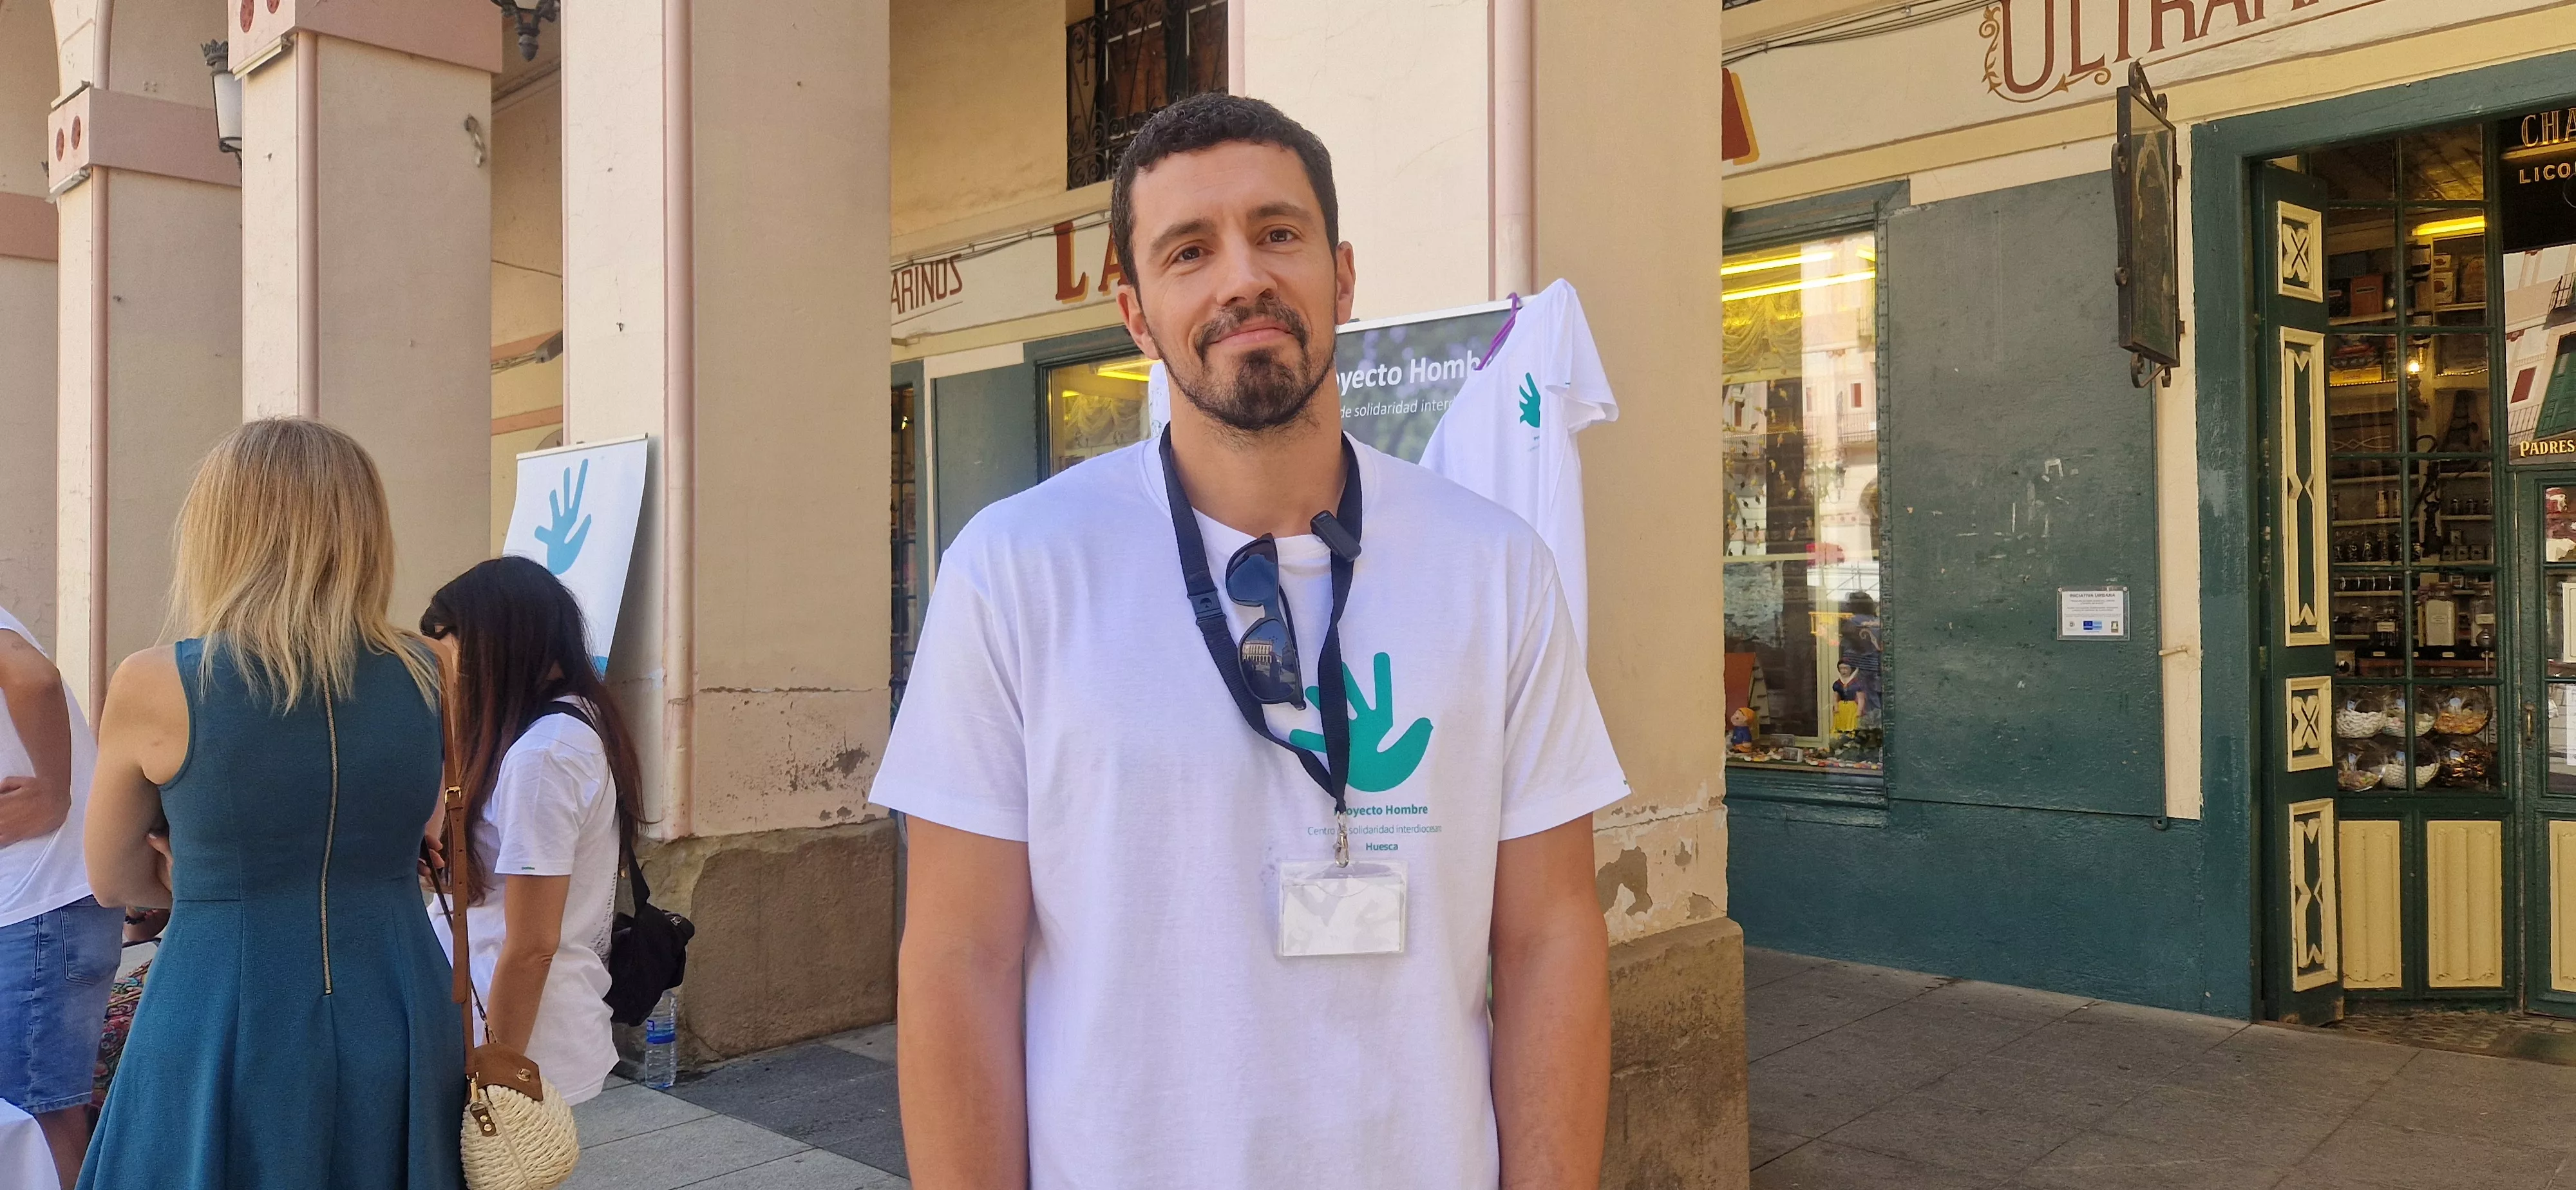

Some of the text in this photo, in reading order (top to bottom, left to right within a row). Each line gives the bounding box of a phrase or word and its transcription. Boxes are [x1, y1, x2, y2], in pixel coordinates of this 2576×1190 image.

[2519, 162, 2576, 184] LICO
[1336, 350, 1493, 396] yecto Homb
[1354, 399, 1417, 417] solidaridad
[2519, 439, 2576, 458] PADRES
[1334, 803, 1428, 818] oyecto Hombre
[1307, 826, 1335, 836] Centro
[1349, 824, 1394, 835] solidaridad
[1365, 842, 1399, 851] Huesca
